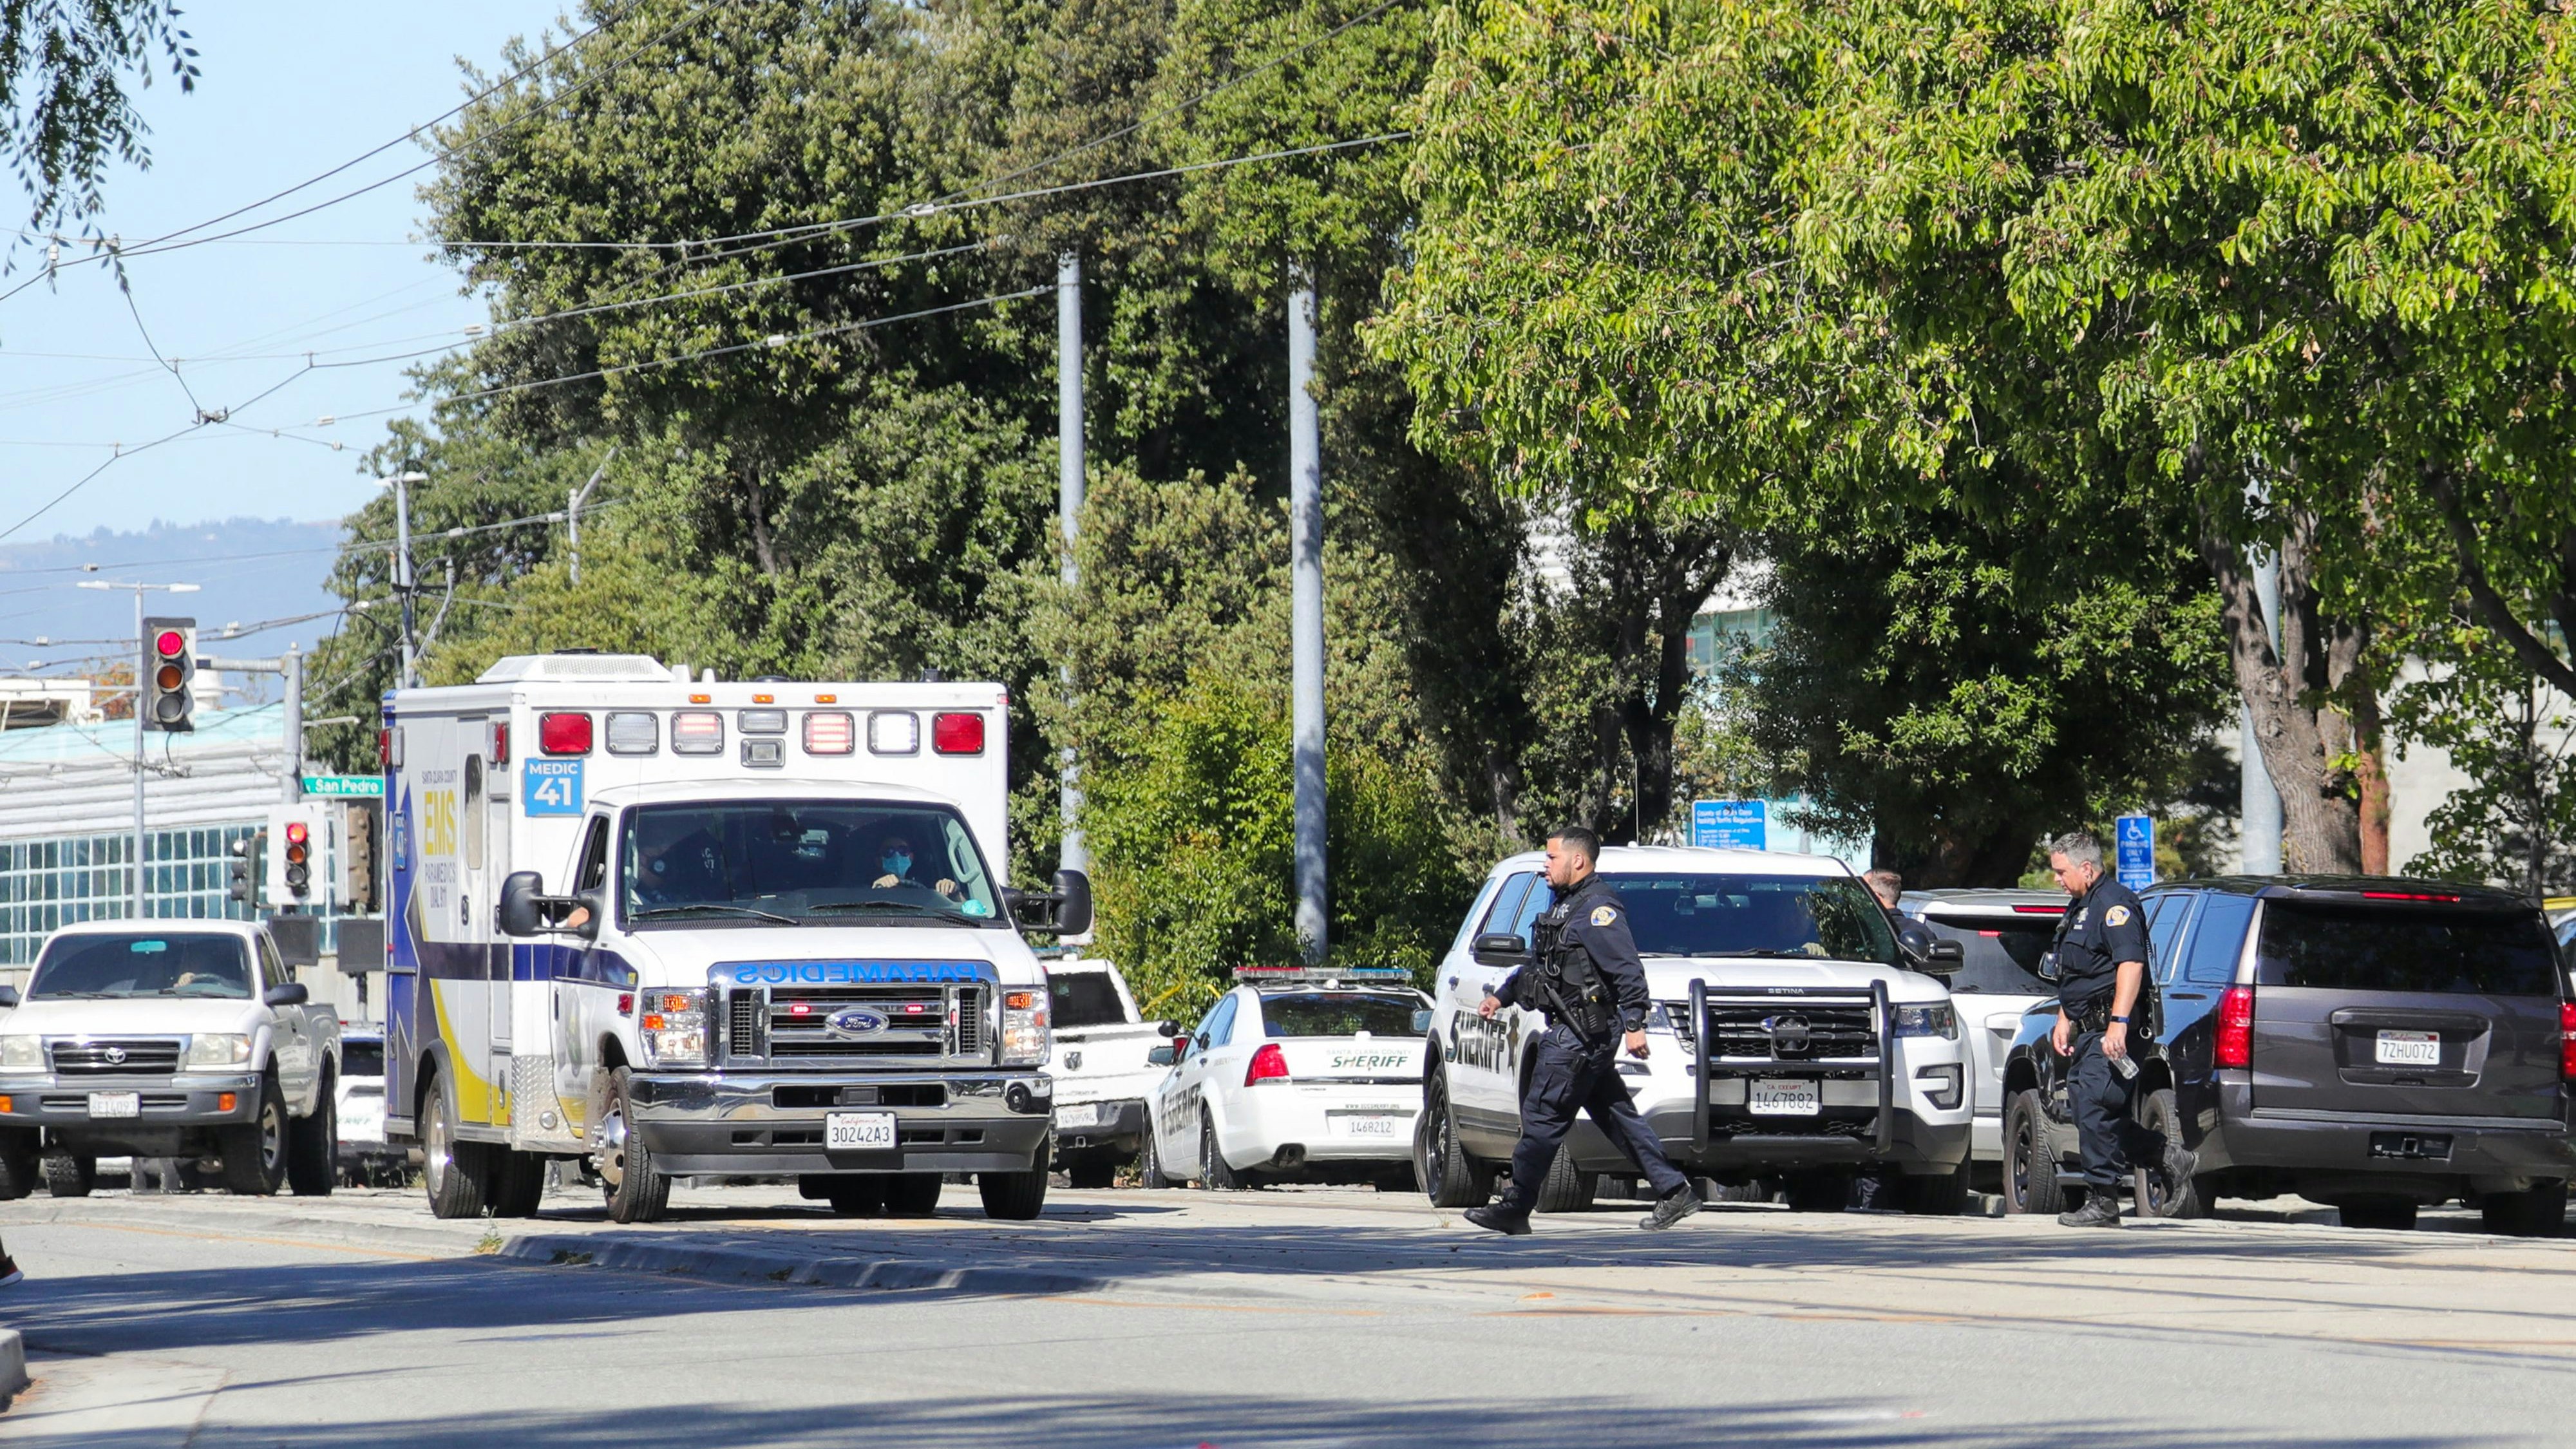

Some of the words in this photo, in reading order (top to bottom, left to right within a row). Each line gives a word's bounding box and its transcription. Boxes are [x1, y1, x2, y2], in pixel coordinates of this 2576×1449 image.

[529, 763, 578, 775] MEDIC
[316, 778, 339, 793] San
[341, 779, 378, 793] Pedro
[534, 778, 572, 806] 41
[424, 790, 455, 855] EMS
[396, 831, 404, 858] 41
[2120, 840, 2149, 848] PARKING
[425, 862, 455, 884] PARAMEDICS
[846, 1017, 872, 1028] Ford
[1445, 1010, 1508, 1074] SHERIFF
[1331, 1056, 1408, 1068] SHERIFF
[1166, 1081, 1202, 1136] SHERIFF
[1756, 1093, 1814, 1109] 1467882
[841, 1116, 879, 1126] California
[1351, 1122, 1392, 1133] 1468212
[832, 1127, 889, 1142] 30242A3
